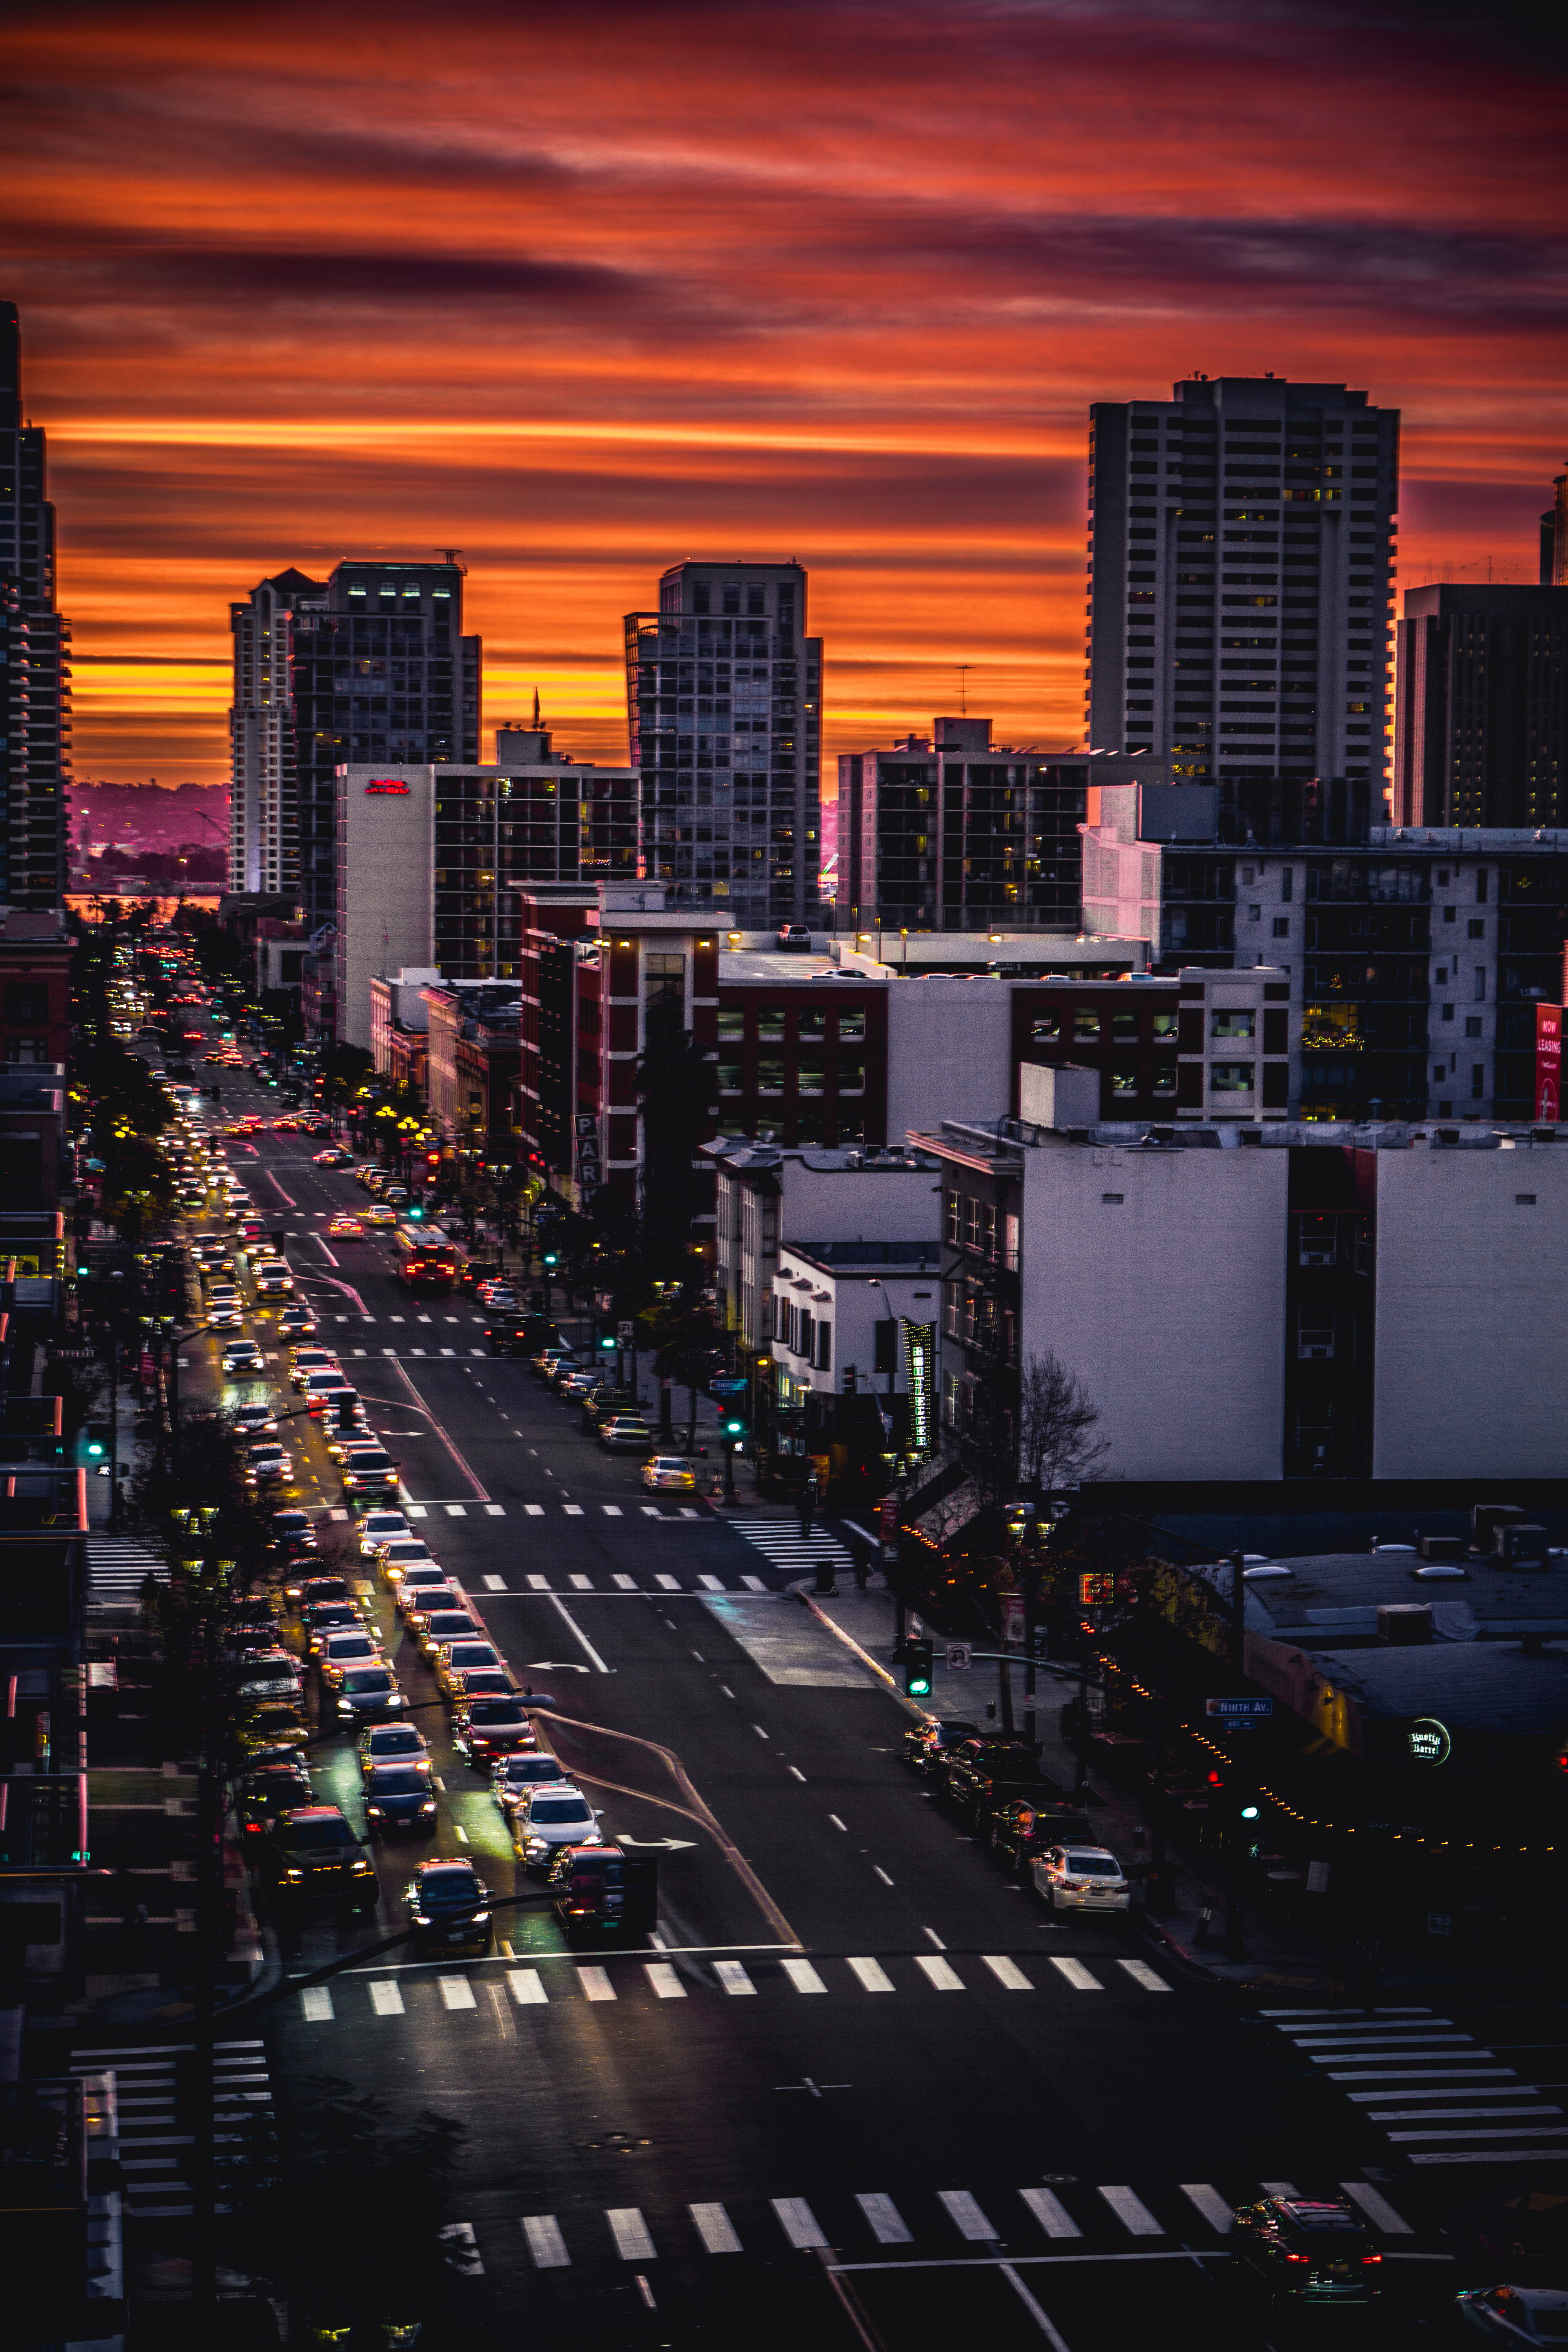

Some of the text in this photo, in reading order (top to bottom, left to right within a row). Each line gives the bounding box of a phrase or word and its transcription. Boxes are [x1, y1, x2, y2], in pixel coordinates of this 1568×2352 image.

[1543, 1020, 1558, 1034] NOW
[1538, 1038, 1561, 1054] LEASING
[1220, 1702, 1250, 1712] NINTH
[1411, 1732, 1442, 1746] Knotty
[1412, 1744, 1439, 1755] Barrel
